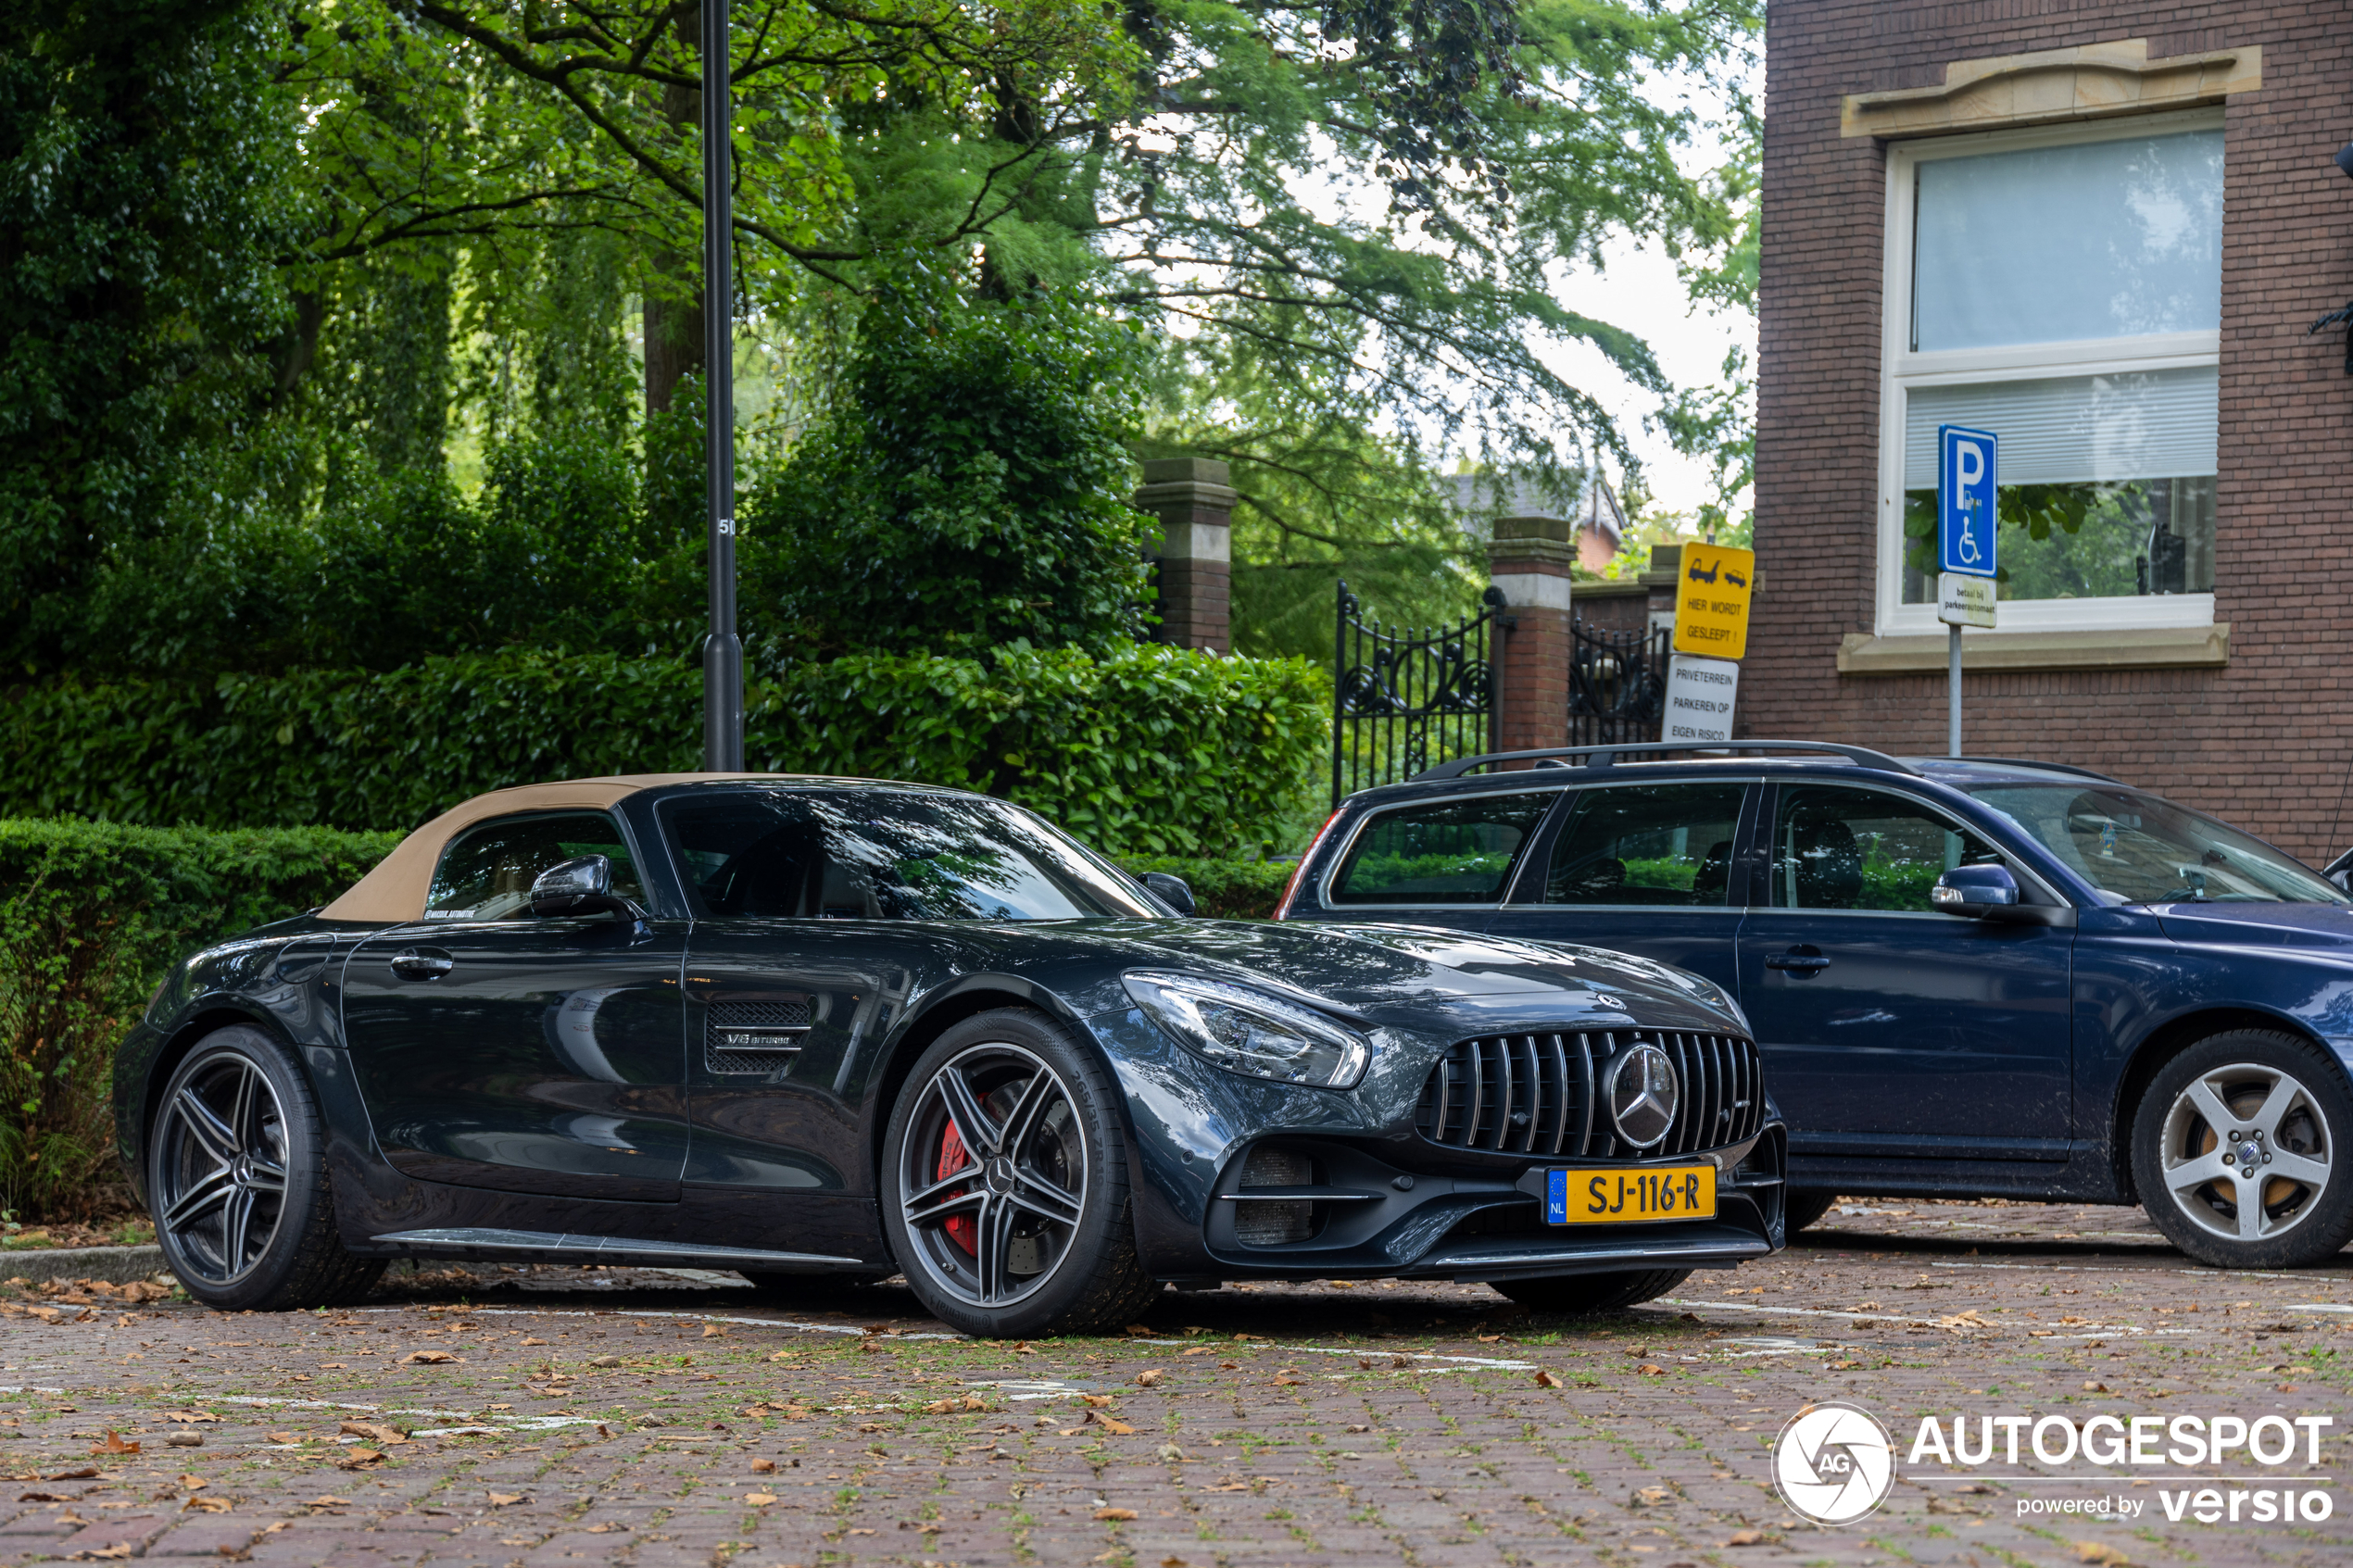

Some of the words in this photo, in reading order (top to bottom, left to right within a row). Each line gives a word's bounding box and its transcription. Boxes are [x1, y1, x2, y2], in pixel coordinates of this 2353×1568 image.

[1957, 439, 1985, 510] P
[1957, 587, 1976, 598] betaal
[1976, 589, 1984, 601] bij
[1687, 597, 1707, 611] HIER
[1711, 600, 1742, 616] WORDT
[1944, 600, 1995, 614] parkeerautomaat
[1687, 625, 1731, 642] GESLEEPT
[1732, 631, 1738, 643] !
[1673, 696, 1717, 712] PARKEREN
[1718, 702, 1730, 714] OP
[1672, 725, 1696, 738] EIGEN
[1698, 728, 1725, 741] RISICO
[750, 1035, 789, 1044] BITURBO
[1071, 1071, 1101, 1132] 265/35
[1093, 1136, 1104, 1162] ZR
[1550, 1202, 1565, 1215] NL
[1588, 1173, 1700, 1214] SJ-116-R
[935, 1299, 992, 1329] Continental
